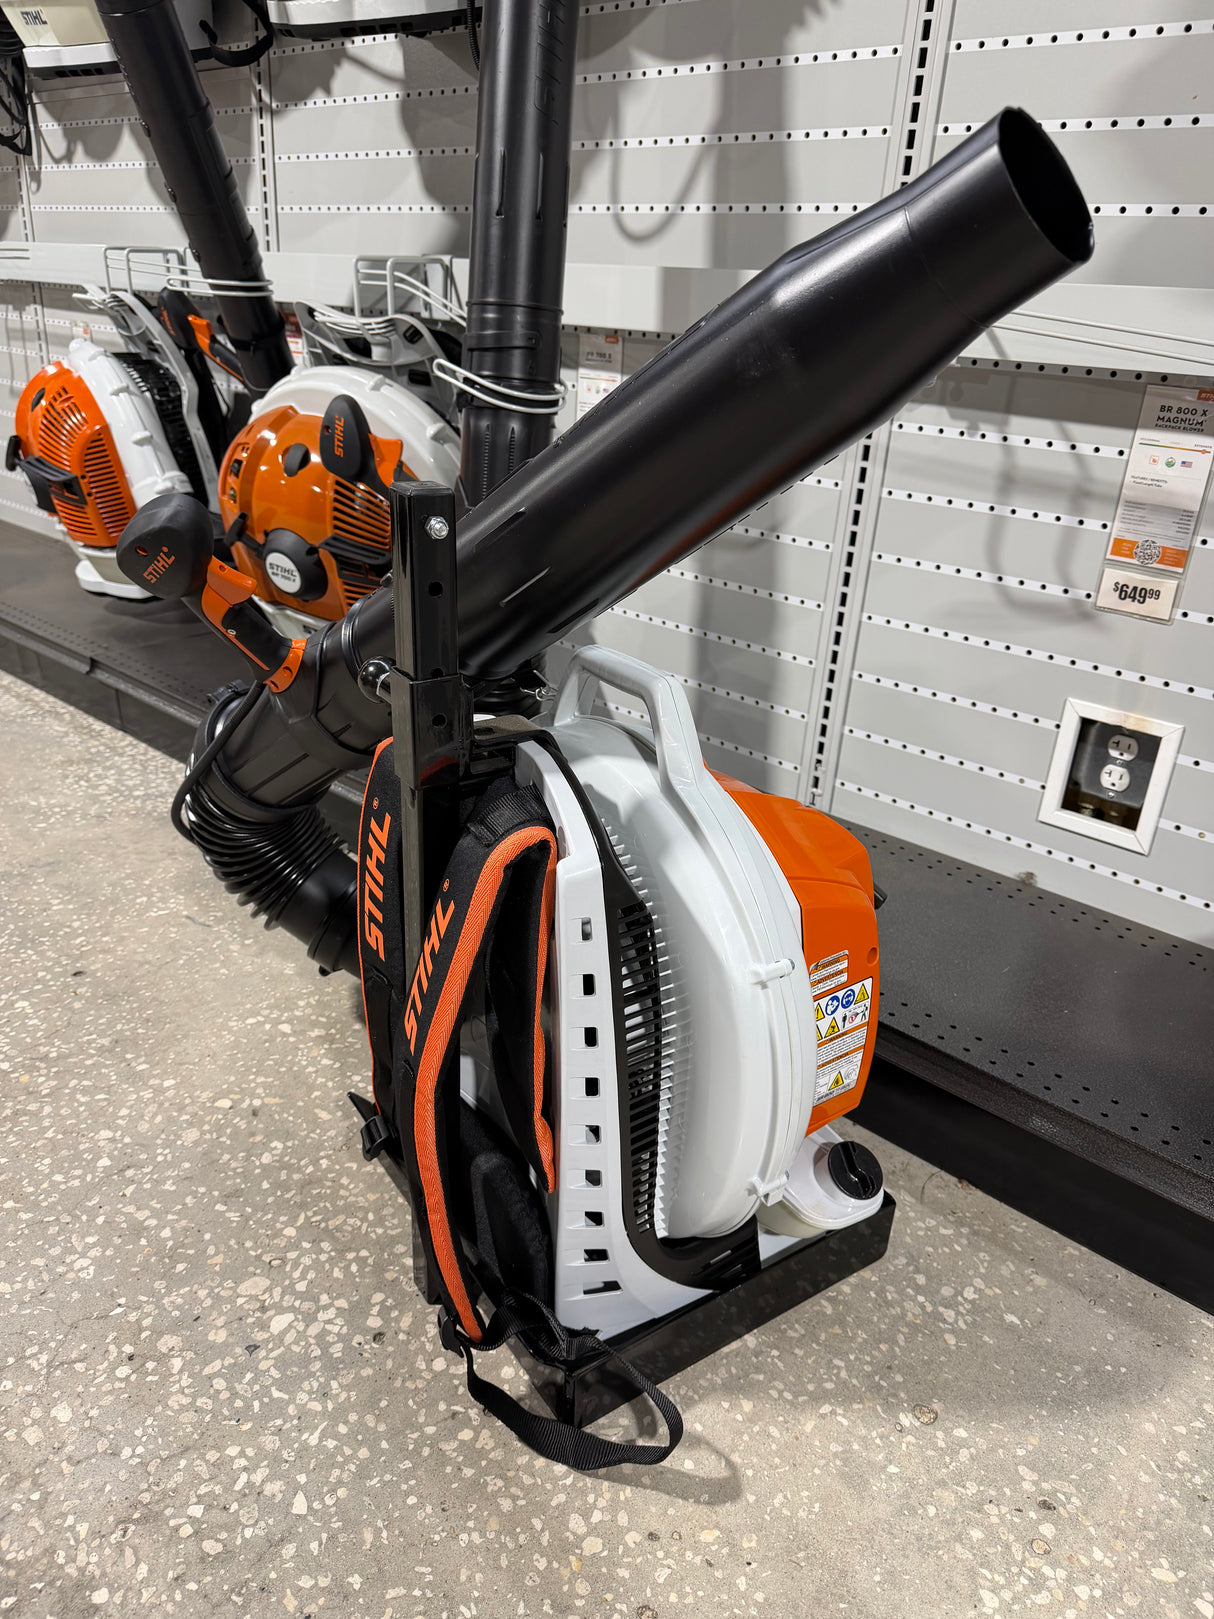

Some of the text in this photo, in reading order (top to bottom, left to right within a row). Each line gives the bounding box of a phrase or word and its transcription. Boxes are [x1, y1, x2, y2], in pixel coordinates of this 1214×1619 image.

[20, 9, 48, 26] STIHL
[1160, 404, 1209, 417] BR 800 X
[1156, 415, 1206, 427] MAGNUM
[334, 415, 345, 458] STIHL
[143, 547, 175, 584] STIHL
[269, 562, 297, 578] STIHL
